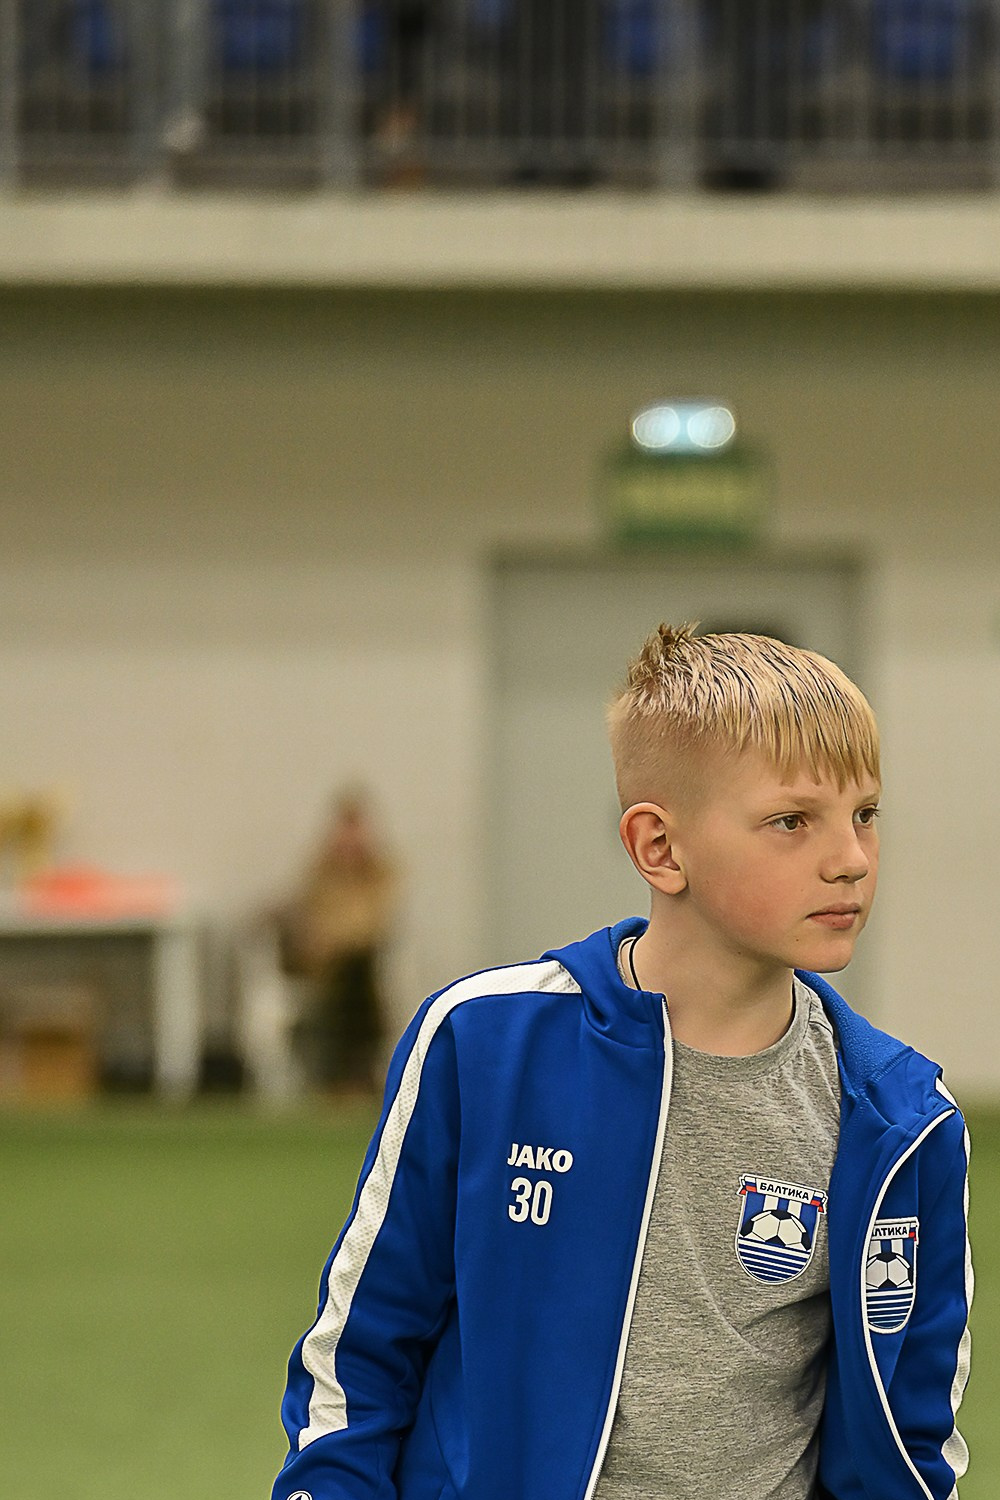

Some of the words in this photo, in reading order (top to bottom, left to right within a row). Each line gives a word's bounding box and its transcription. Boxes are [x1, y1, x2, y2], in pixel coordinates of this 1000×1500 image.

[507, 1143, 574, 1173] JAKO
[508, 1177, 553, 1226] 30
[759, 1182, 810, 1201] БАЛТИКА
[871, 1226, 908, 1237] ЛТИКА
